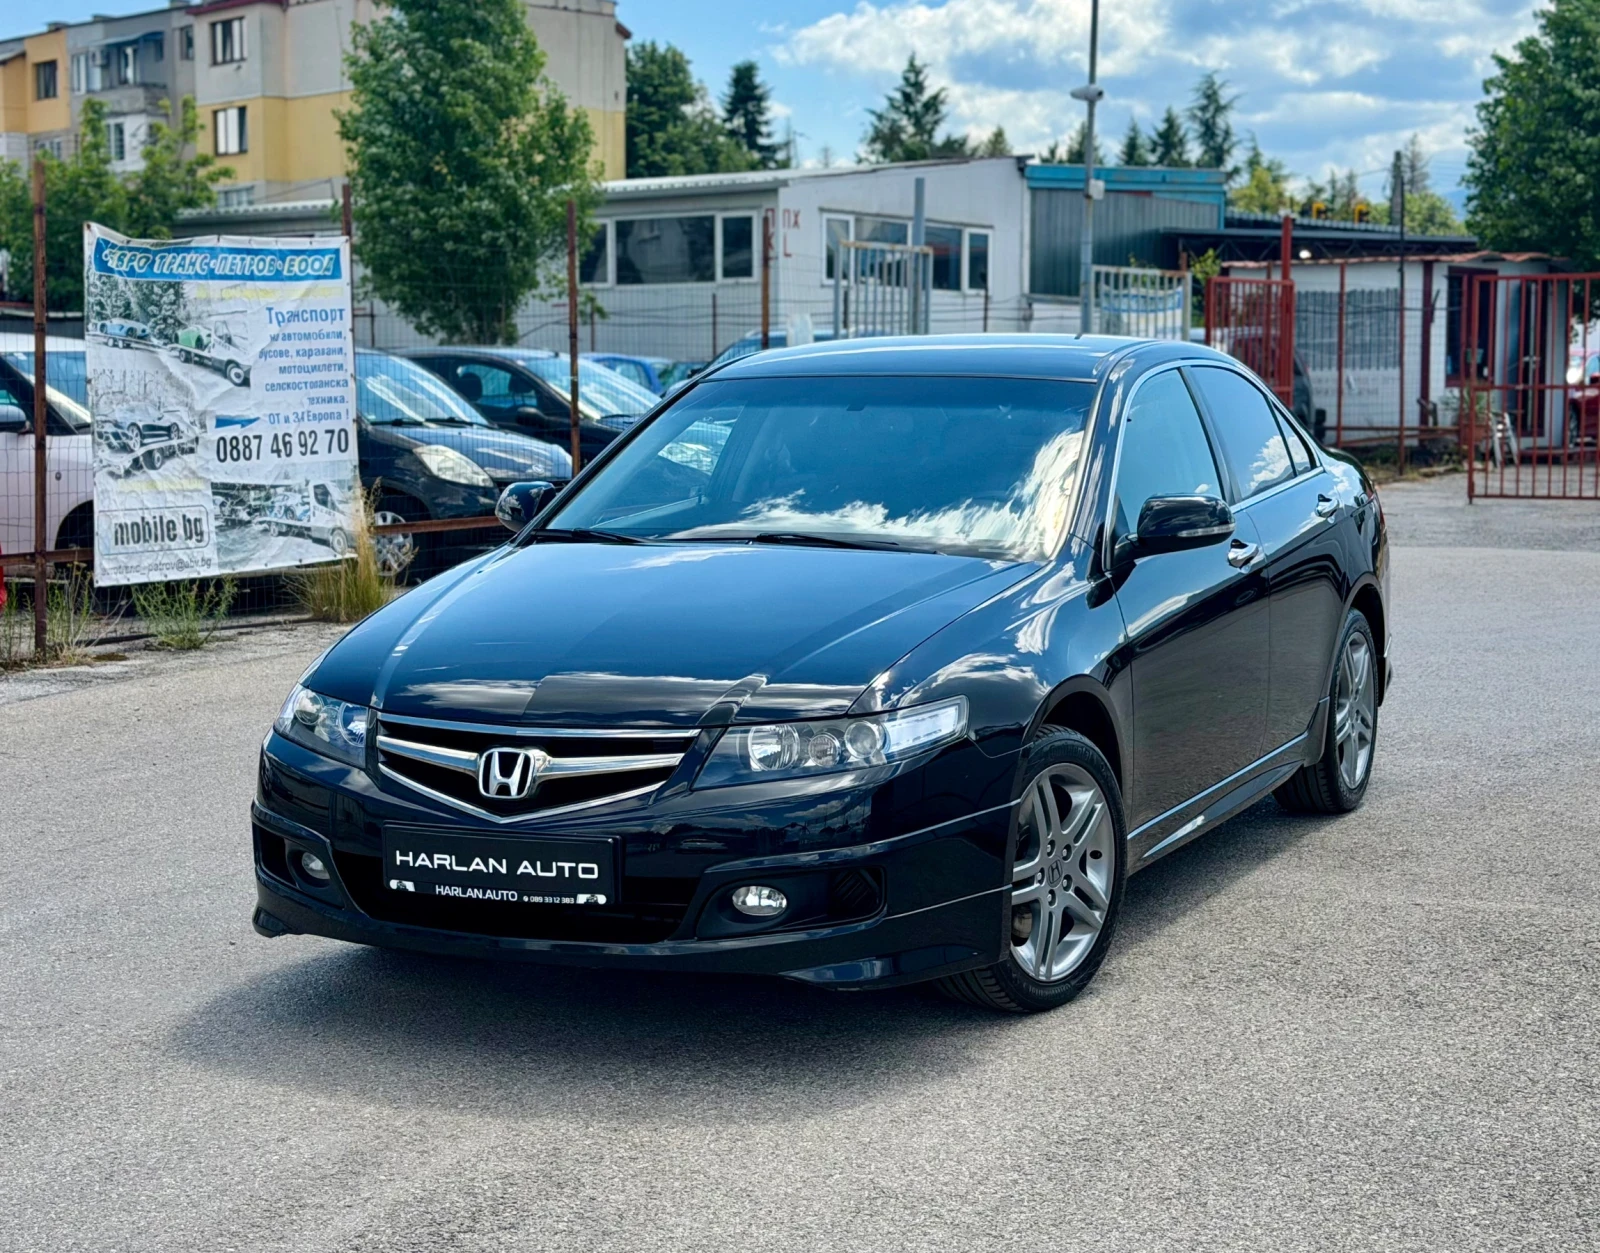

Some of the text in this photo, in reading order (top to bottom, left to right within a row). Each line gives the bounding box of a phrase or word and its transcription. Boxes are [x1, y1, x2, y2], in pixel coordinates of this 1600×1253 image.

[153, 253, 210, 275] ТРАНС
[214, 253, 277, 276] ПЕТРОВ
[283, 253, 336, 276] ЕООД
[266, 307, 346, 327] Транспорт
[281, 329, 346, 342] автомобили,
[295, 347, 347, 360] каравани,
[265, 379, 349, 392] селскостопанска
[268, 412, 281, 425] ОТ
[284, 414, 291, 424] и
[306, 410, 342, 424] Европа
[216, 428, 350, 463] 0887 46 92 70
[395, 850, 599, 879] HARLAN AUTO
[435, 884, 518, 902] HARLAN.AUTO
[553, 896, 561, 904] 12
